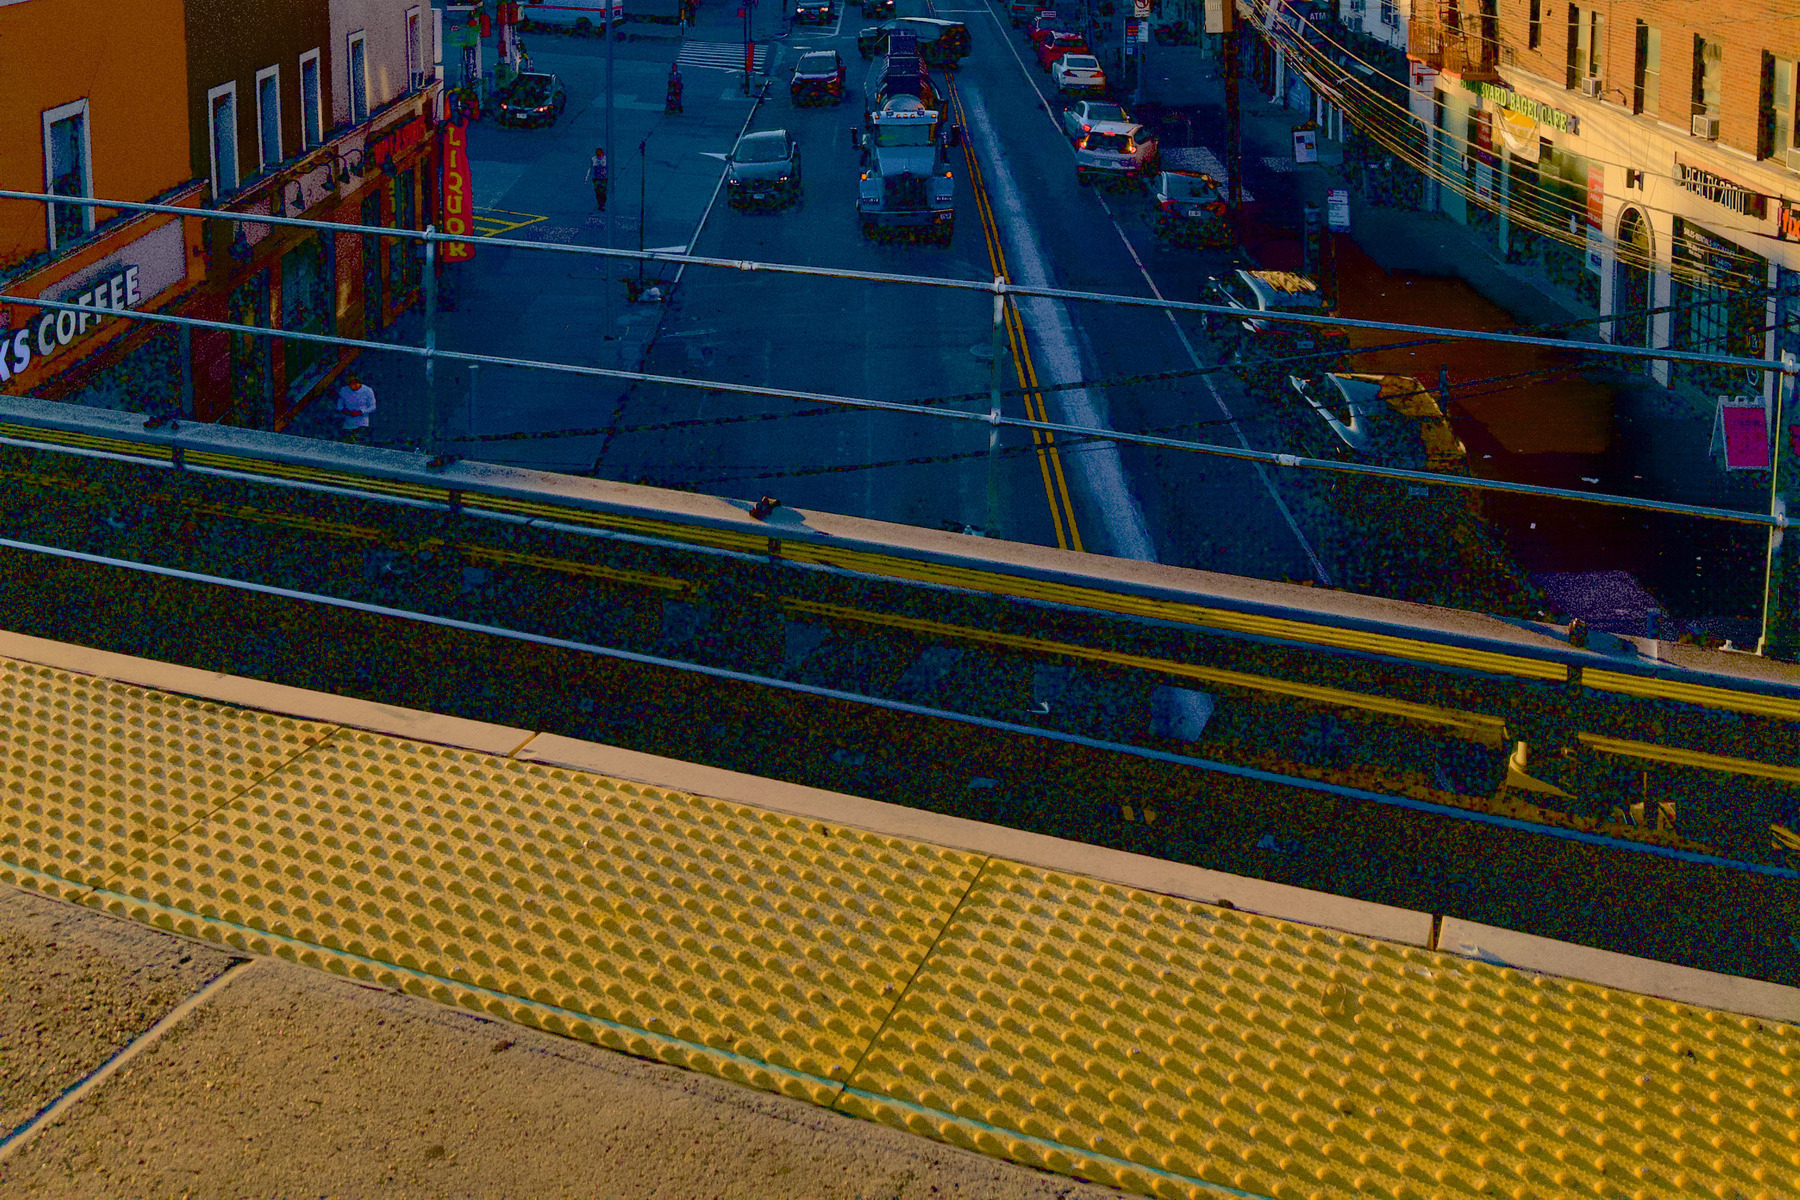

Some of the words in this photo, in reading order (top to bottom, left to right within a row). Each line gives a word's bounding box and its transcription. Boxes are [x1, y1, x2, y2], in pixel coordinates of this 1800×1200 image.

[1309, 11, 1327, 21] ATM
[1509, 92, 1540, 121] BAGEL
[1541, 105, 1568, 133] CAFE
[446, 126, 468, 257] LIQUOR
[1685, 166, 1718, 203] REALTY
[38, 266, 140, 357] COFFEE
